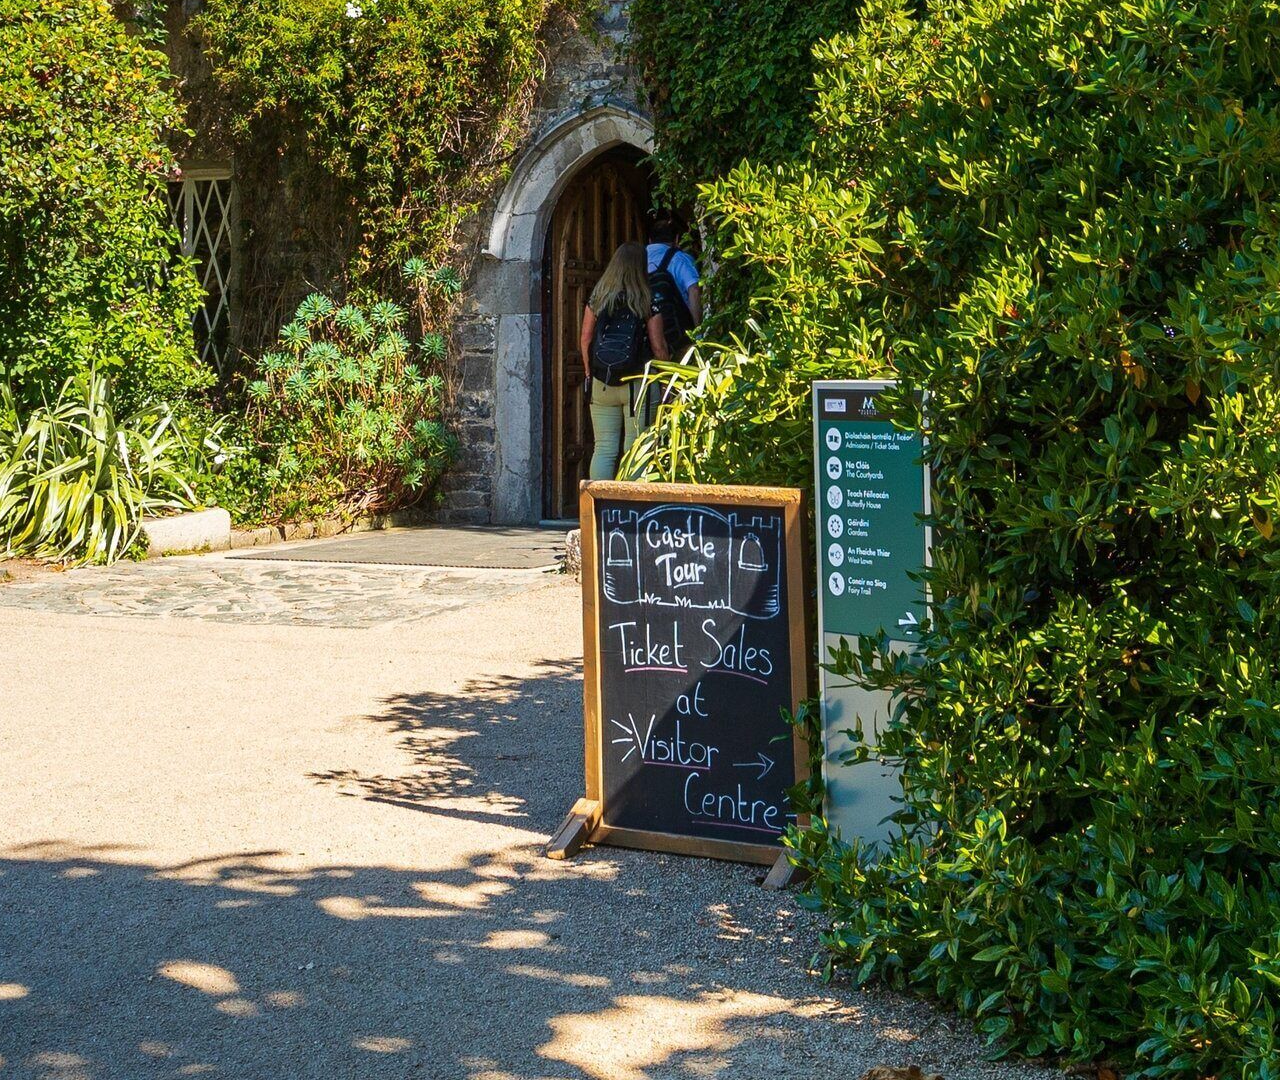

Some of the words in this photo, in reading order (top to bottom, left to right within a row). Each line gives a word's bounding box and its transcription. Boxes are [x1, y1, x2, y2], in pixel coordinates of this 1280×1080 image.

[846, 461, 854, 469] Na
[846, 470, 855, 478] The
[856, 471, 883, 480] Courtyards
[847, 489, 862, 497] Teach
[847, 500, 865, 510] Butterfly
[866, 501, 881, 509] House
[646, 515, 716, 559] Castle
[848, 528, 868, 536] Gardens
[877, 549, 891, 557] Thiar
[655, 553, 707, 587] Tour
[848, 577, 865, 585] Conair
[848, 586, 860, 596] Fairy
[861, 587, 871, 595] Trail
[609, 622, 688, 668] Ticket
[700, 619, 774, 676] Sales
[677, 682, 709, 717] at
[629, 713, 720, 767] Visitor
[684, 773, 782, 830] Centre
